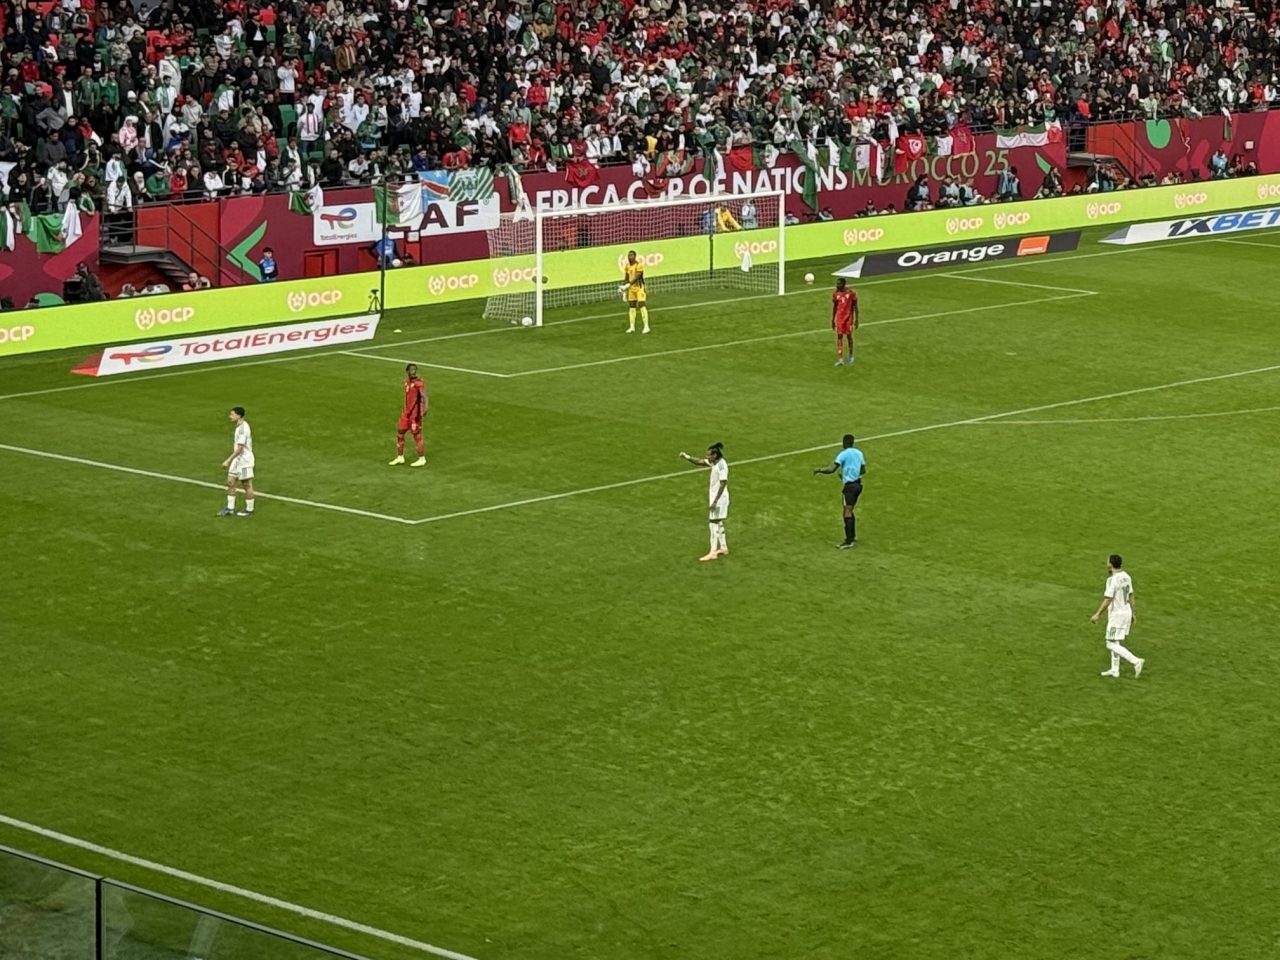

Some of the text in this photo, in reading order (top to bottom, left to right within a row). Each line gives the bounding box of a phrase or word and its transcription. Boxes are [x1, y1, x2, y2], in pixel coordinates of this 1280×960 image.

[512, 184, 621, 223] AFRICA
[852, 153, 979, 188] MOCCO
[984, 149, 1010, 176] 25
[1187, 193, 1207, 204] OCP
[1099, 202, 1121, 214] OCP
[960, 218, 983, 230] OCP
[1007, 212, 1030, 225] OCP
[858, 228, 884, 242] OCP
[750, 240, 777, 254] OCP
[897, 243, 1005, 267] Orange
[447, 274, 479, 289] OCP
[307, 290, 343, 306] OCP
[157, 306, 195, 324] OCP
[181, 321, 370, 357] TotalEnergies
